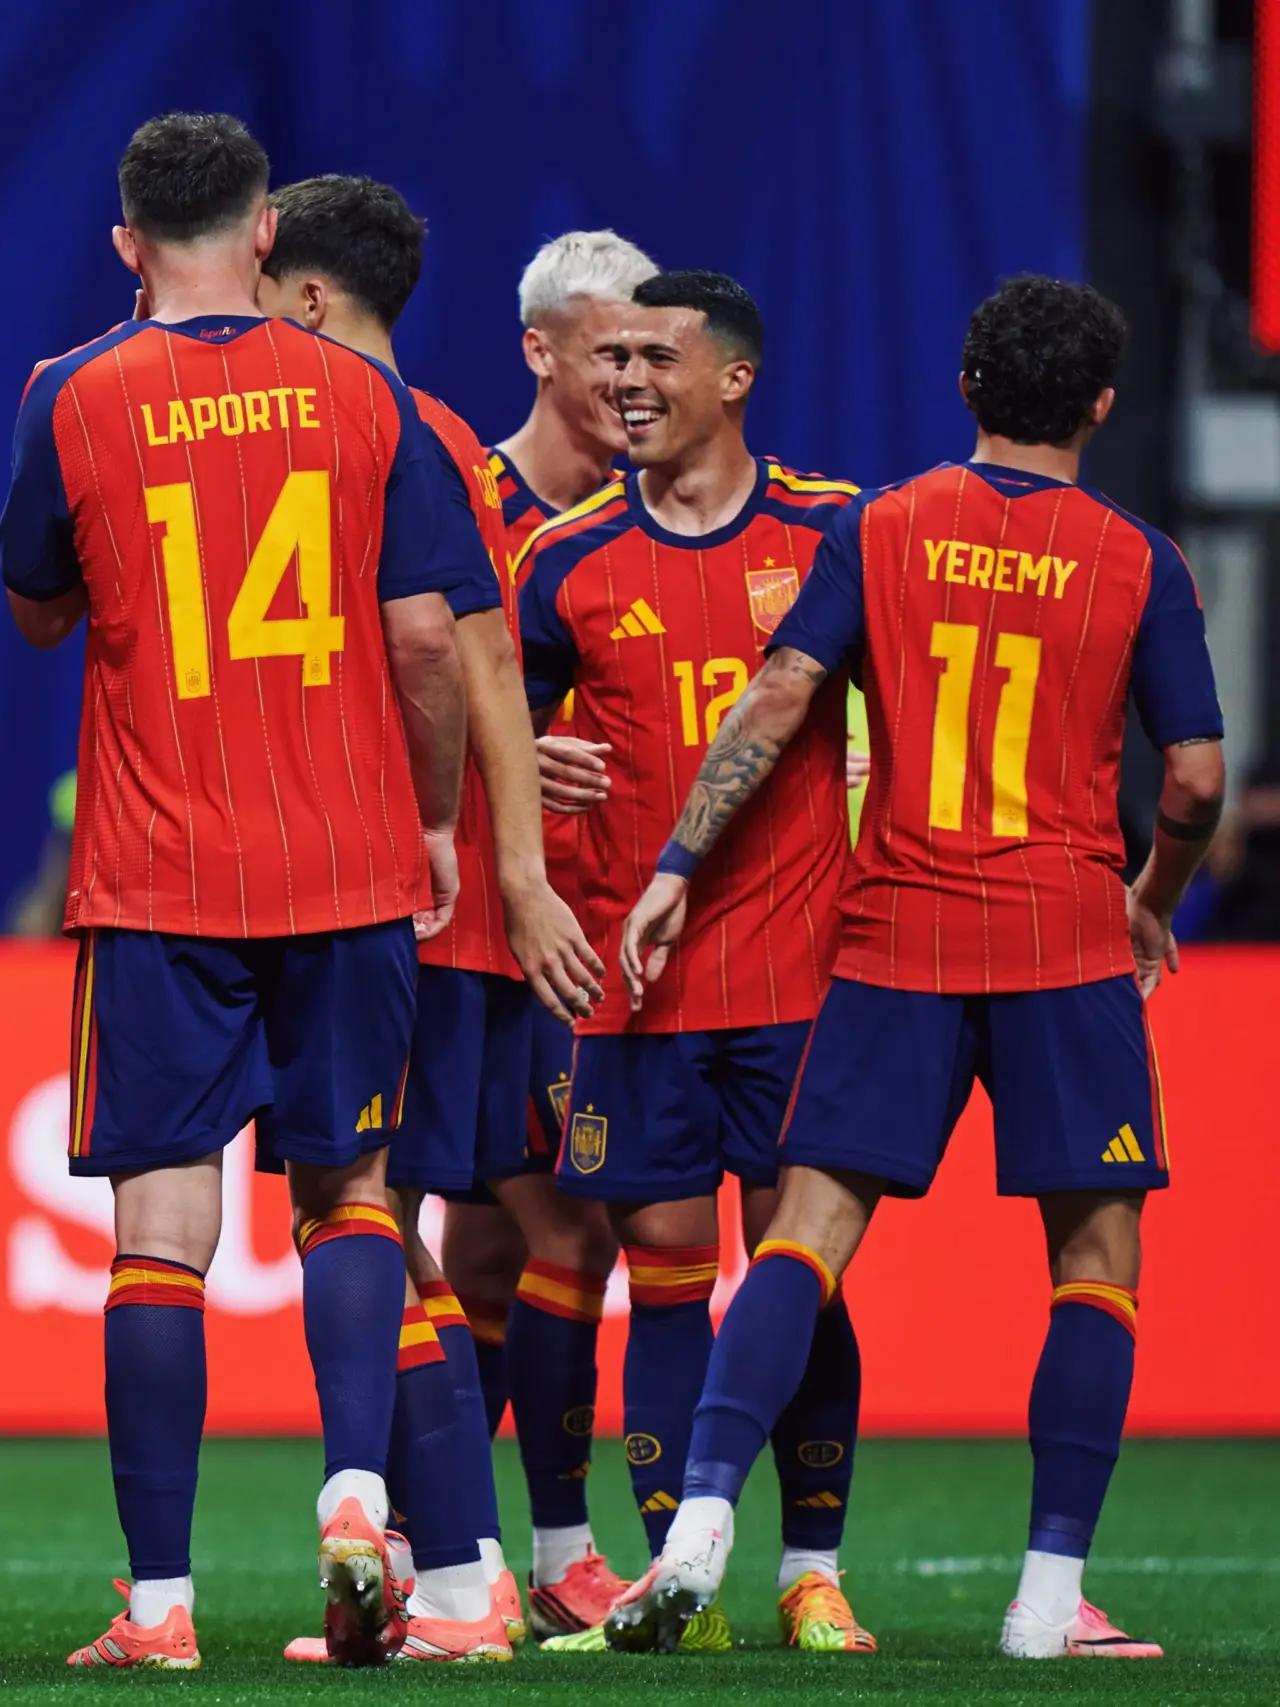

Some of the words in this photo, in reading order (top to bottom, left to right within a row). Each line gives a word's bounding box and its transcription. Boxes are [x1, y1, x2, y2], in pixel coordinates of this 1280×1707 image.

[141, 387, 321, 446] LAPORTE
[143, 470, 345, 700] 14
[924, 539, 1078, 599] YEREMY
[672, 657, 748, 746] 12
[928, 622, 1042, 838] 11
